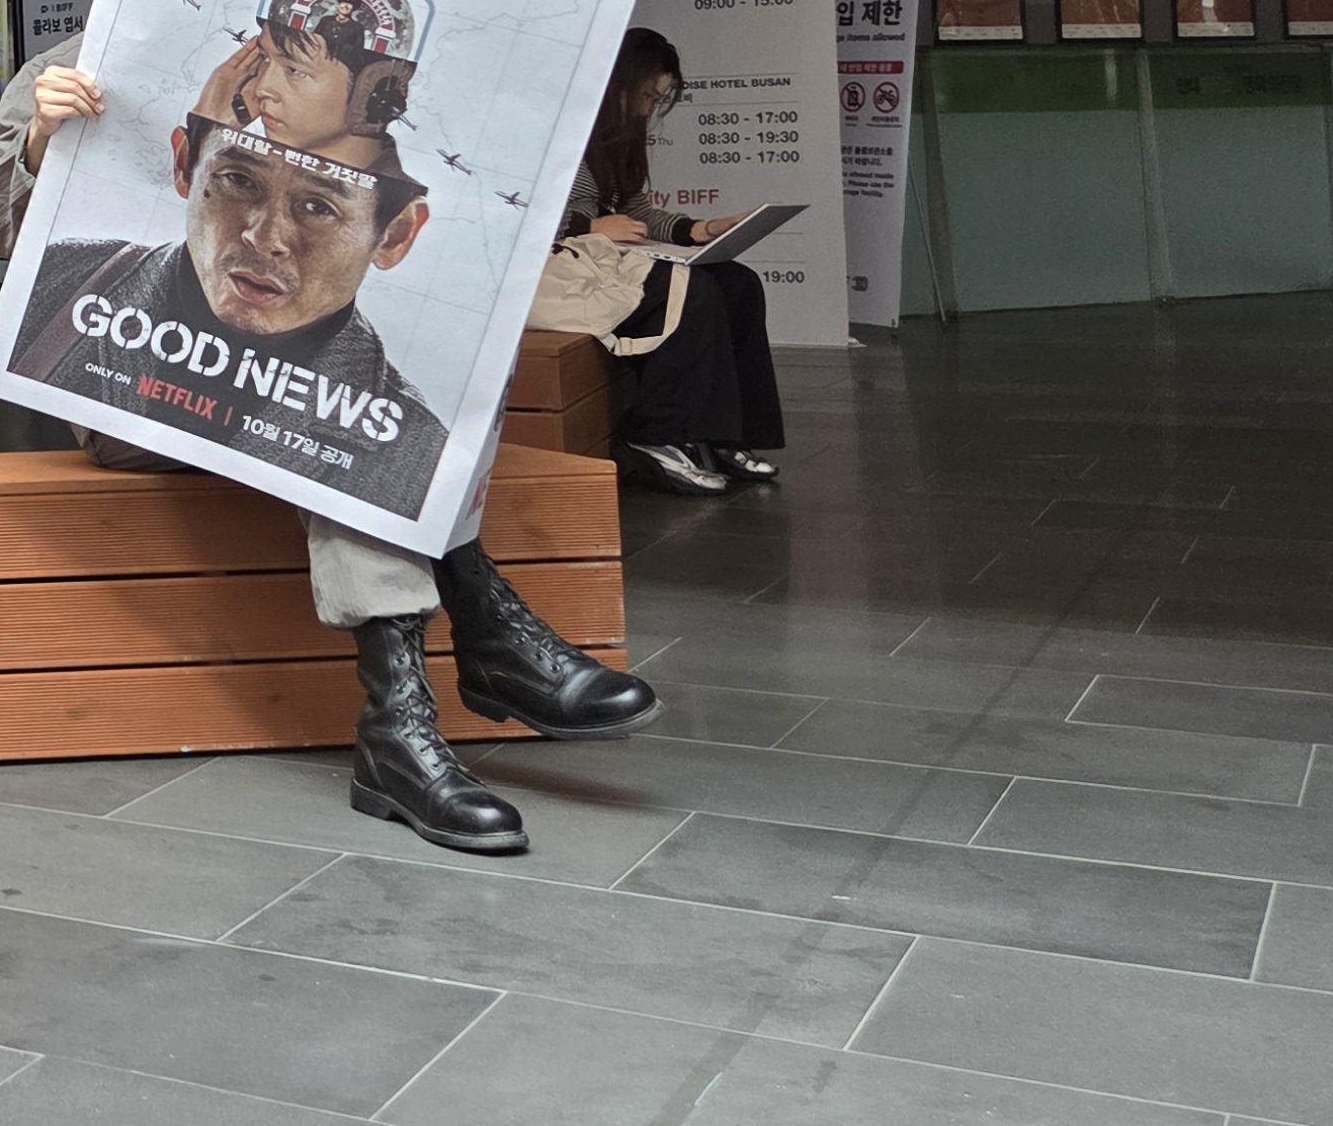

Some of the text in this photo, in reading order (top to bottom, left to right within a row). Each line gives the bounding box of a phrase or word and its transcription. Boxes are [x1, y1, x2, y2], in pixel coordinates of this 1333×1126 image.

[861, 0, 903, 26] 제한
[33, 15, 85, 36] 콜라보 엽서
[710, 78, 748, 89] HOTEL
[751, 77, 792, 88] BUSAN
[698, 113, 740, 126] 08:30
[756, 110, 798, 124] 17:00
[657, 136, 674, 146] Thu
[698, 132, 740, 145] 08:30
[756, 130, 799, 144] 19:30
[220, 128, 273, 156] 위대할
[284, 149, 321, 172] 뻔한
[323, 162, 379, 190] 거짓말
[699, 152, 741, 164] 08:30
[757, 150, 800, 163] 17:00
[677, 189, 720, 205] BIFF
[762, 270, 806, 284] 19:00
[71, 293, 232, 378] GOOD
[233, 347, 404, 442] NEWS
[84, 362, 355, 471] ONLY ON NETFLIX 10월 17일 공개
